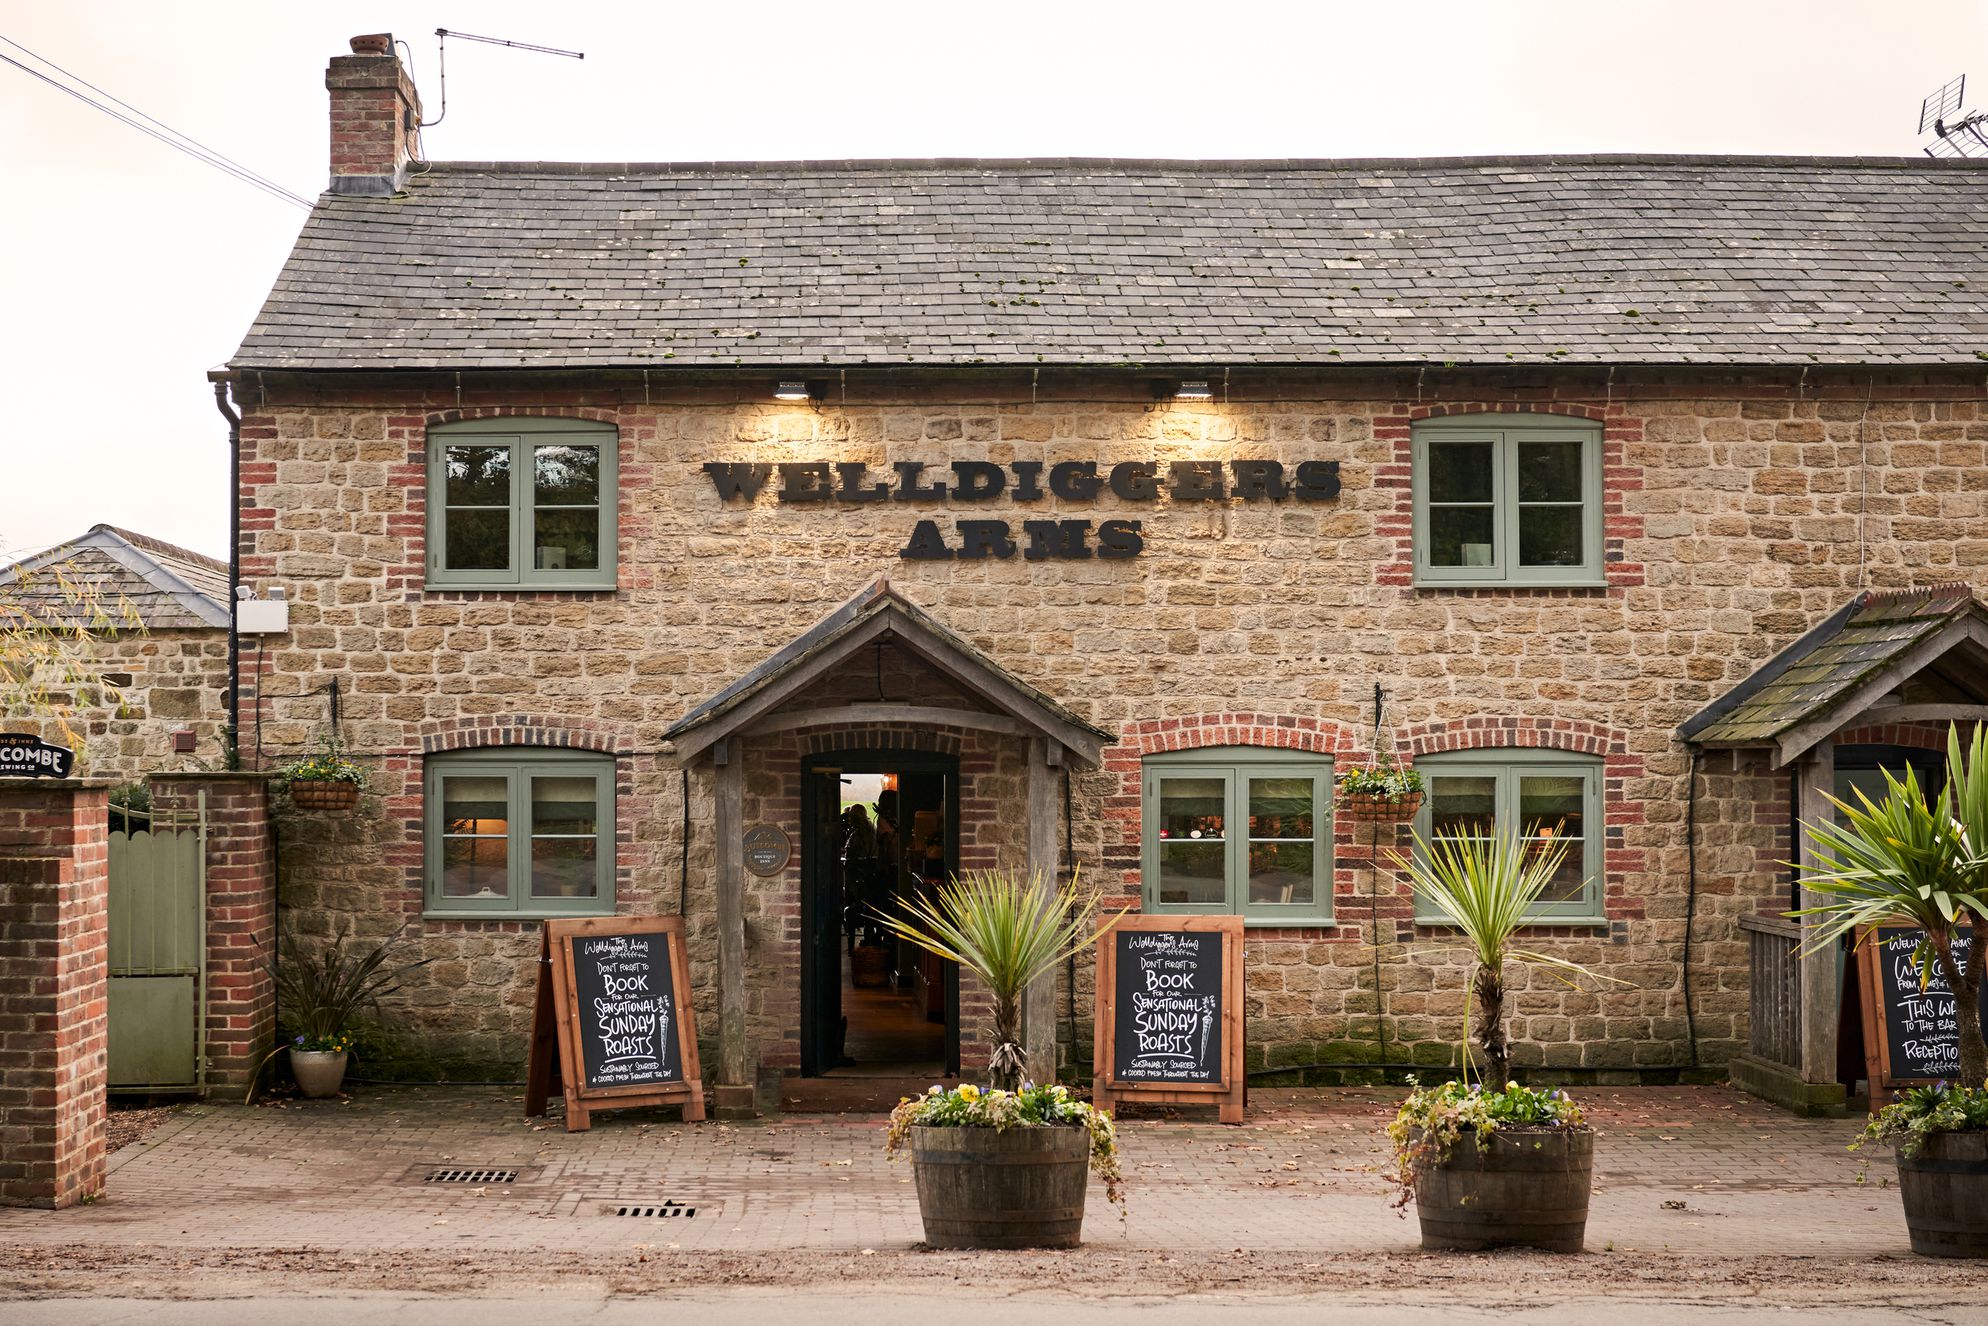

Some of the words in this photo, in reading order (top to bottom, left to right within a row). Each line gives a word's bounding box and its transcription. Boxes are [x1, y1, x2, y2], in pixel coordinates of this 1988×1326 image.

[703, 460, 1341, 501] WELLDIGGERS
[900, 519, 1144, 559] ARMS
[0, 747, 63, 773] COMBE
[619, 962, 641, 972] FORGET
[641, 963, 649, 971] TO
[1164, 960, 1188, 970] FORGET
[1188, 961, 1197, 969] TO
[1894, 955, 1967, 980] WECOE
[603, 974, 648, 995] BOOK
[1146, 970, 1194, 991] BOOK
[1897, 979, 1917, 991] FROM
[594, 997, 658, 1018] SENSATIONAL
[611, 993, 623, 1001] FOR
[1133, 992, 1202, 1012] SENSATIONAL
[1938, 1000, 1957, 1016] WA
[598, 1013, 655, 1039] SUNDAY
[1133, 1011, 1198, 1034] SUNDAY
[1901, 1020, 1914, 1032] TO
[1913, 1019, 1934, 1032] THE
[1937, 1018, 1958, 1030] BAR
[603, 1035, 654, 1057] ROASTS
[1138, 1033, 1192, 1054] ROASTS
[1902, 1040, 1958, 1060] RECEPTIO
[634, 1061, 659, 1071] SOURCED
[1169, 1060, 1197, 1069] SOURCED
